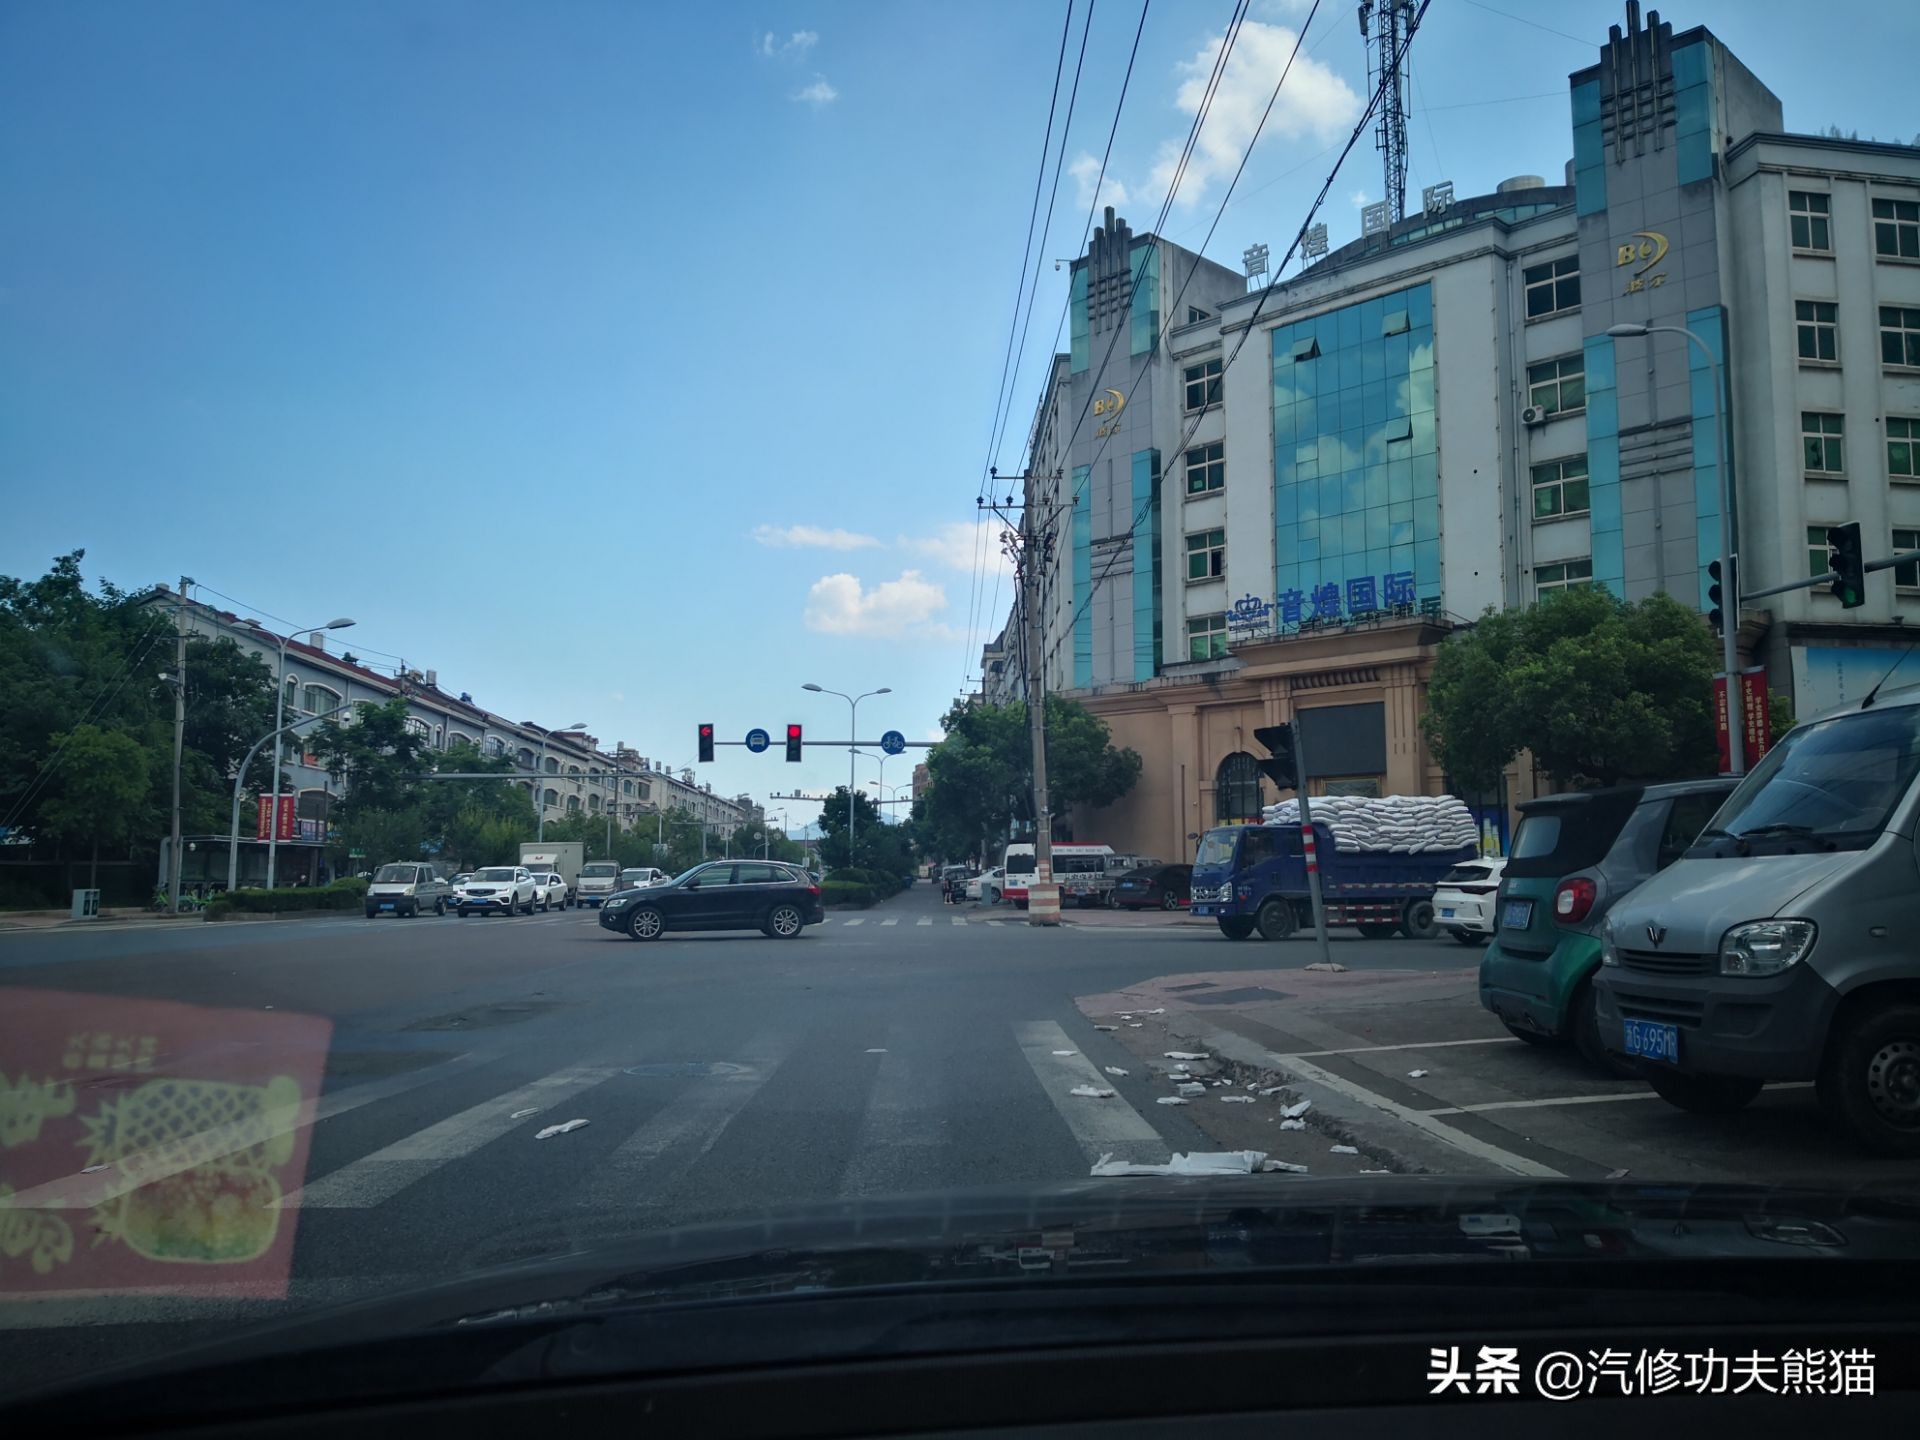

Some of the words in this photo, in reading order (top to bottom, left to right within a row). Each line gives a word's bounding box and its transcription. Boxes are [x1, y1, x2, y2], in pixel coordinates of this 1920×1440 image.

[1242, 181, 1456, 277] 音煌国际
[1278, 571, 1416, 624] 音煌国际
